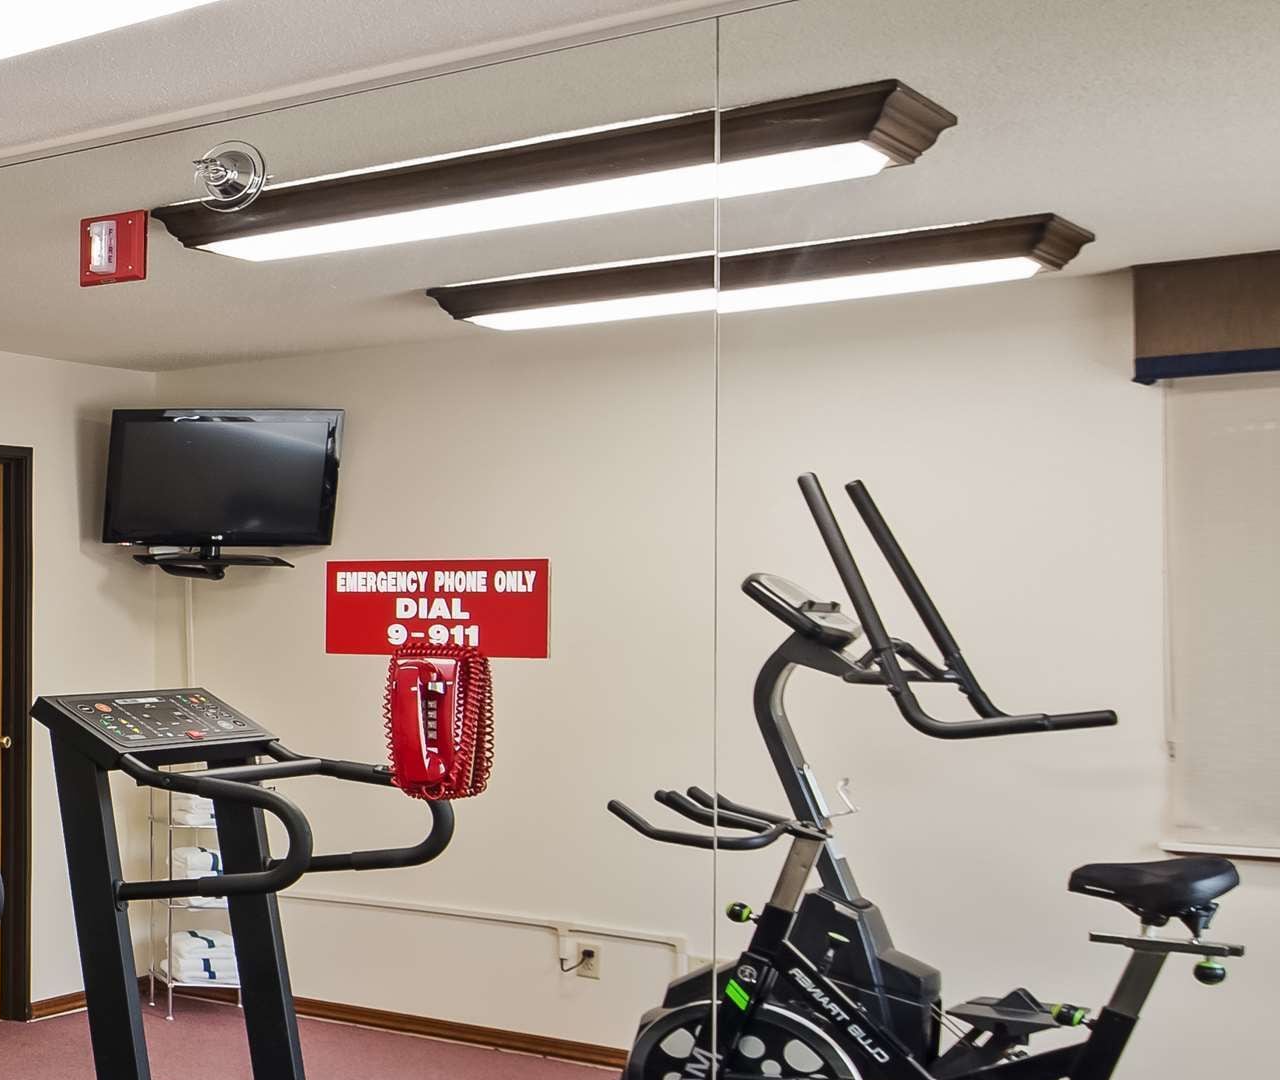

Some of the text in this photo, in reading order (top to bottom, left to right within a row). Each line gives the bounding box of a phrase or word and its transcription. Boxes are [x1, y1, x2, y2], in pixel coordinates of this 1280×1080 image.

[336, 569, 537, 593] EMERGENCY PHONE ONLY
[395, 597, 471, 620] DIAL
[386, 623, 480, 647] 9-911
